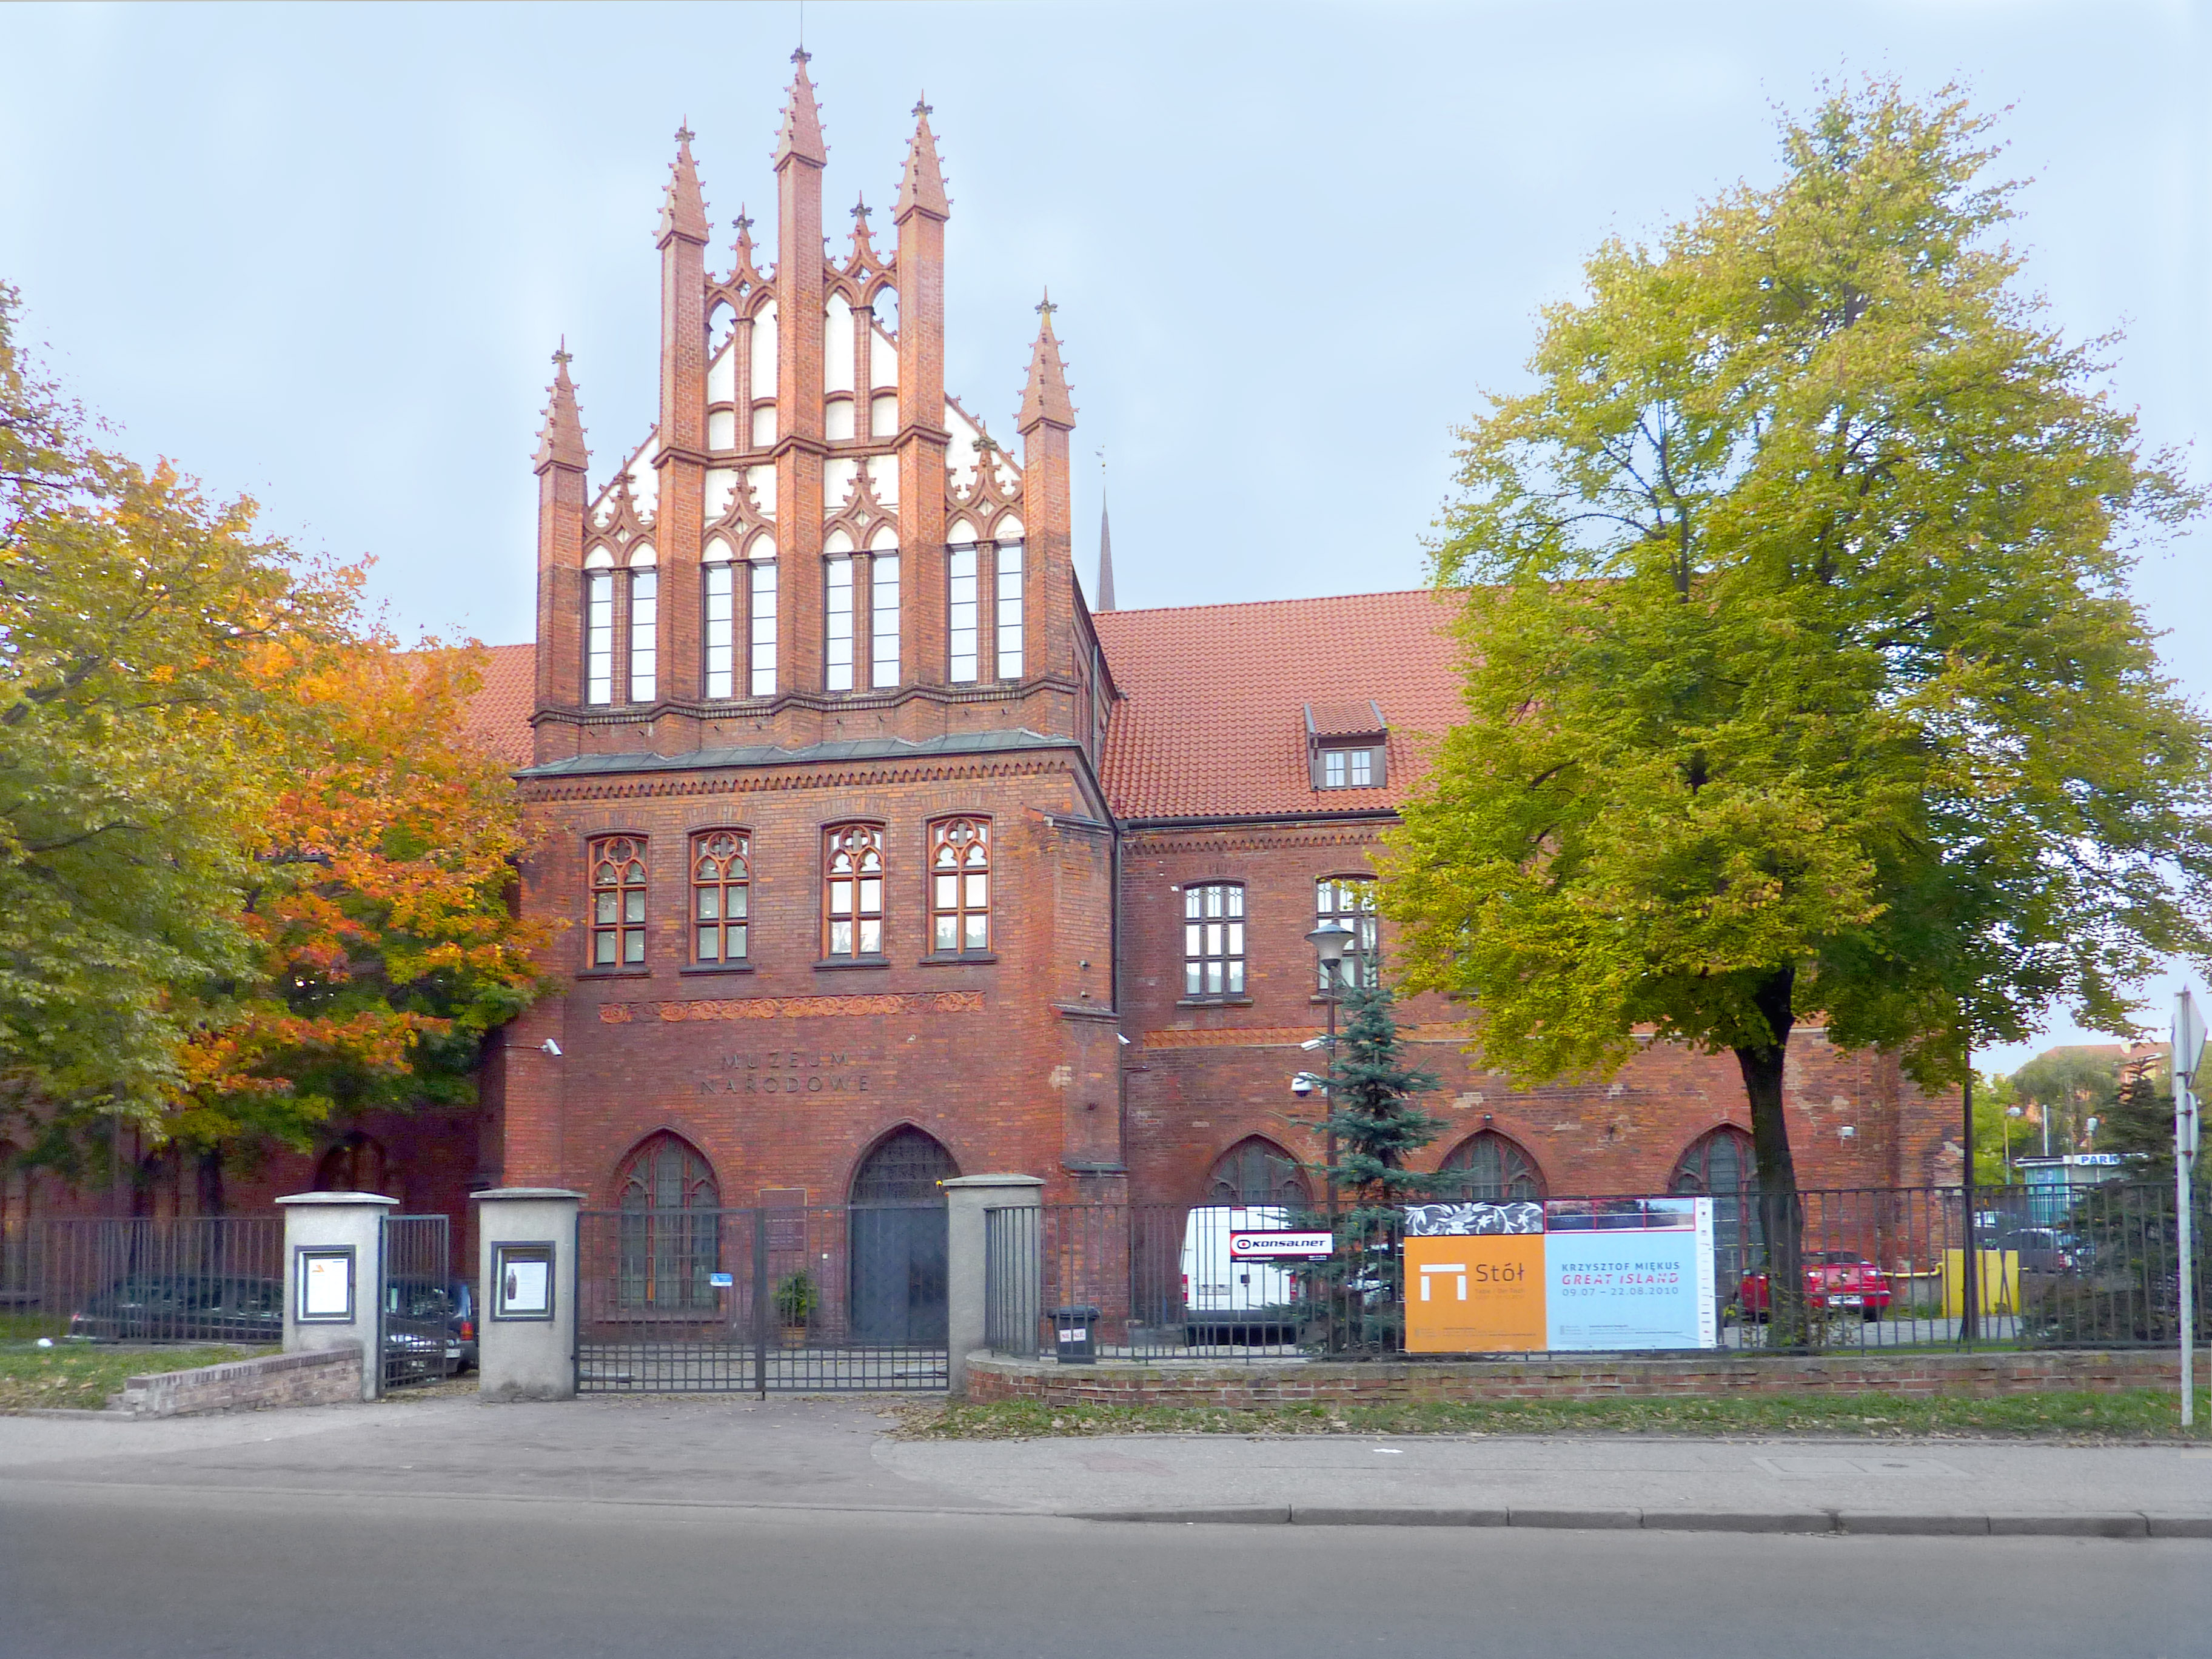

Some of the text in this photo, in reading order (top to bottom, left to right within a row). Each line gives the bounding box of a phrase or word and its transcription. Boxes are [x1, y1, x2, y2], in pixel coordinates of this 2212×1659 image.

[723, 1052, 849, 1069] MUZEUM
[700, 1075, 869, 1094] NARODOWE
[1476, 1262, 1524, 1282] Stół
[1562, 1262, 1680, 1272] KRZYSZTOF MIĘKUS
[1562, 1274, 1613, 1285] GREAT
[1610, 1287, 1678, 1296] 22.08.2010
